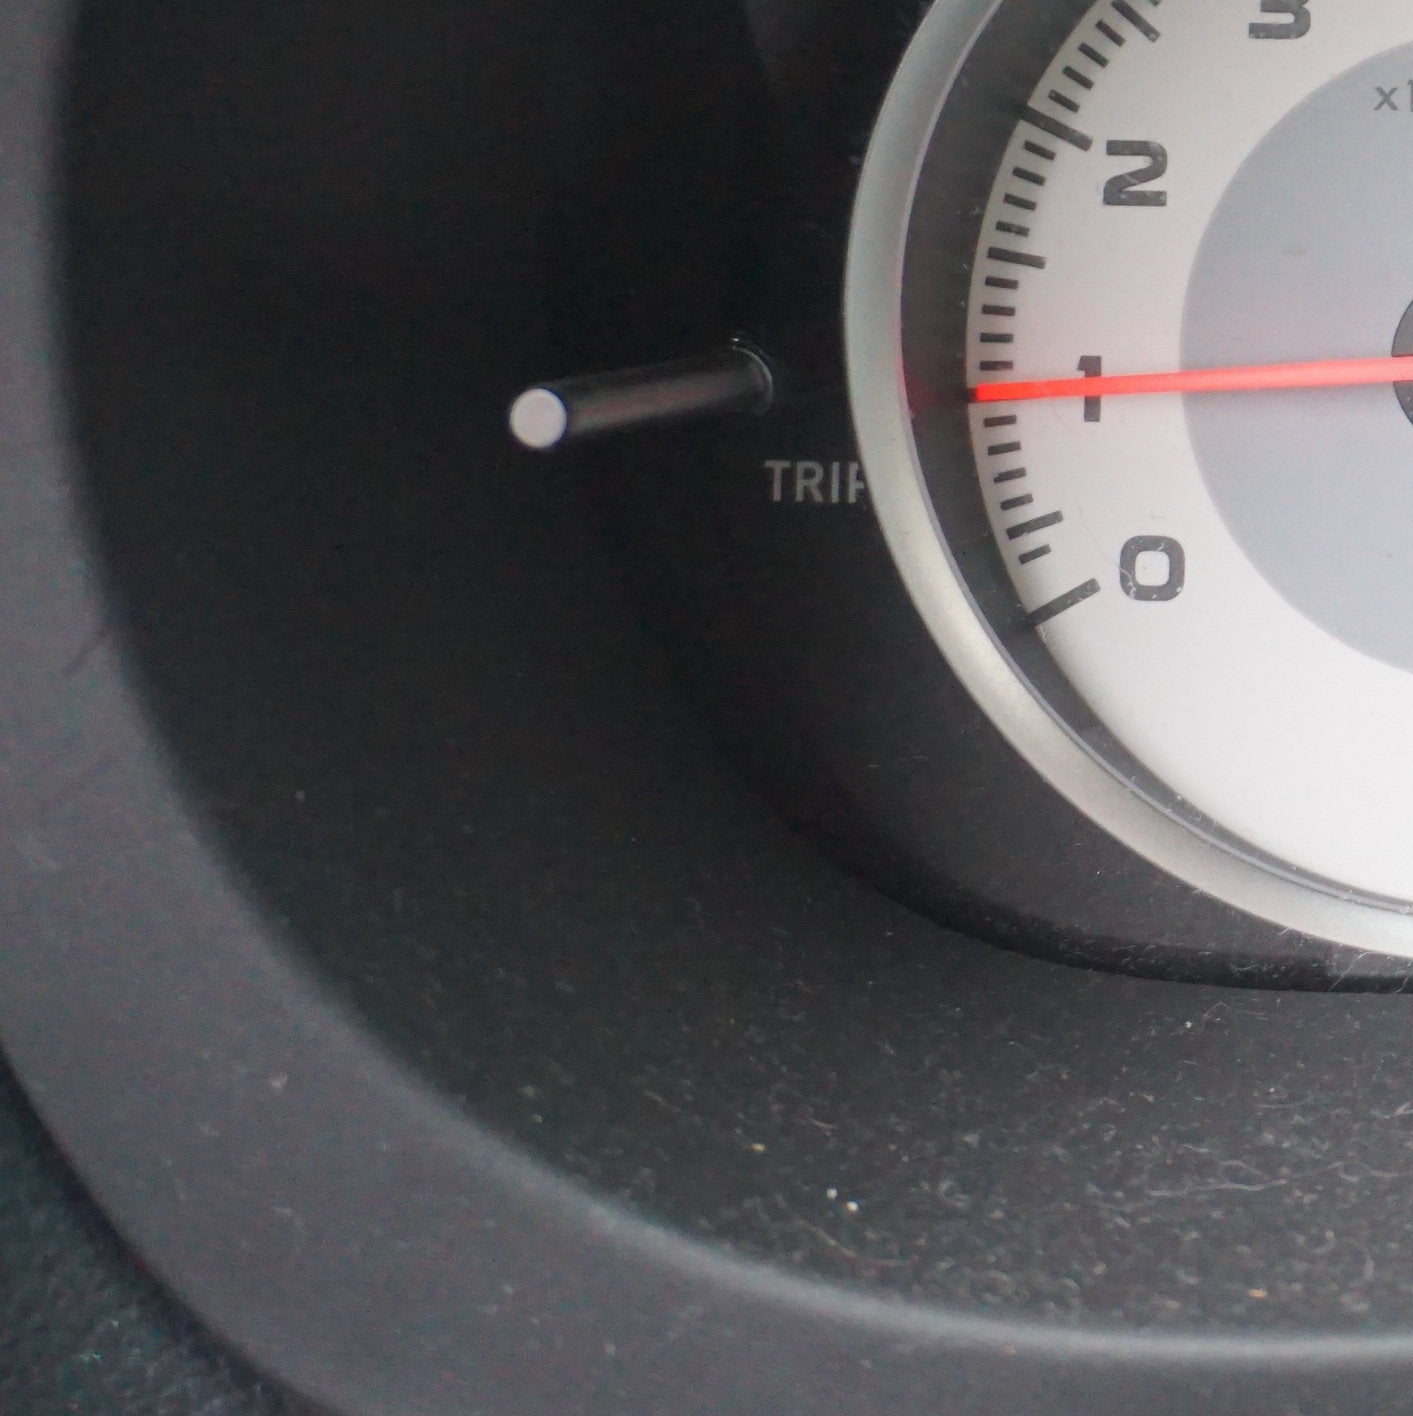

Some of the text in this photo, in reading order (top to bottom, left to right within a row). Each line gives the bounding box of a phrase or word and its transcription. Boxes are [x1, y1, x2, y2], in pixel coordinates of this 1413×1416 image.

[1101, 139, 1168, 208] 2
[1076, 355, 1102, 422] 1
[1118, 534, 1186, 602] 0
